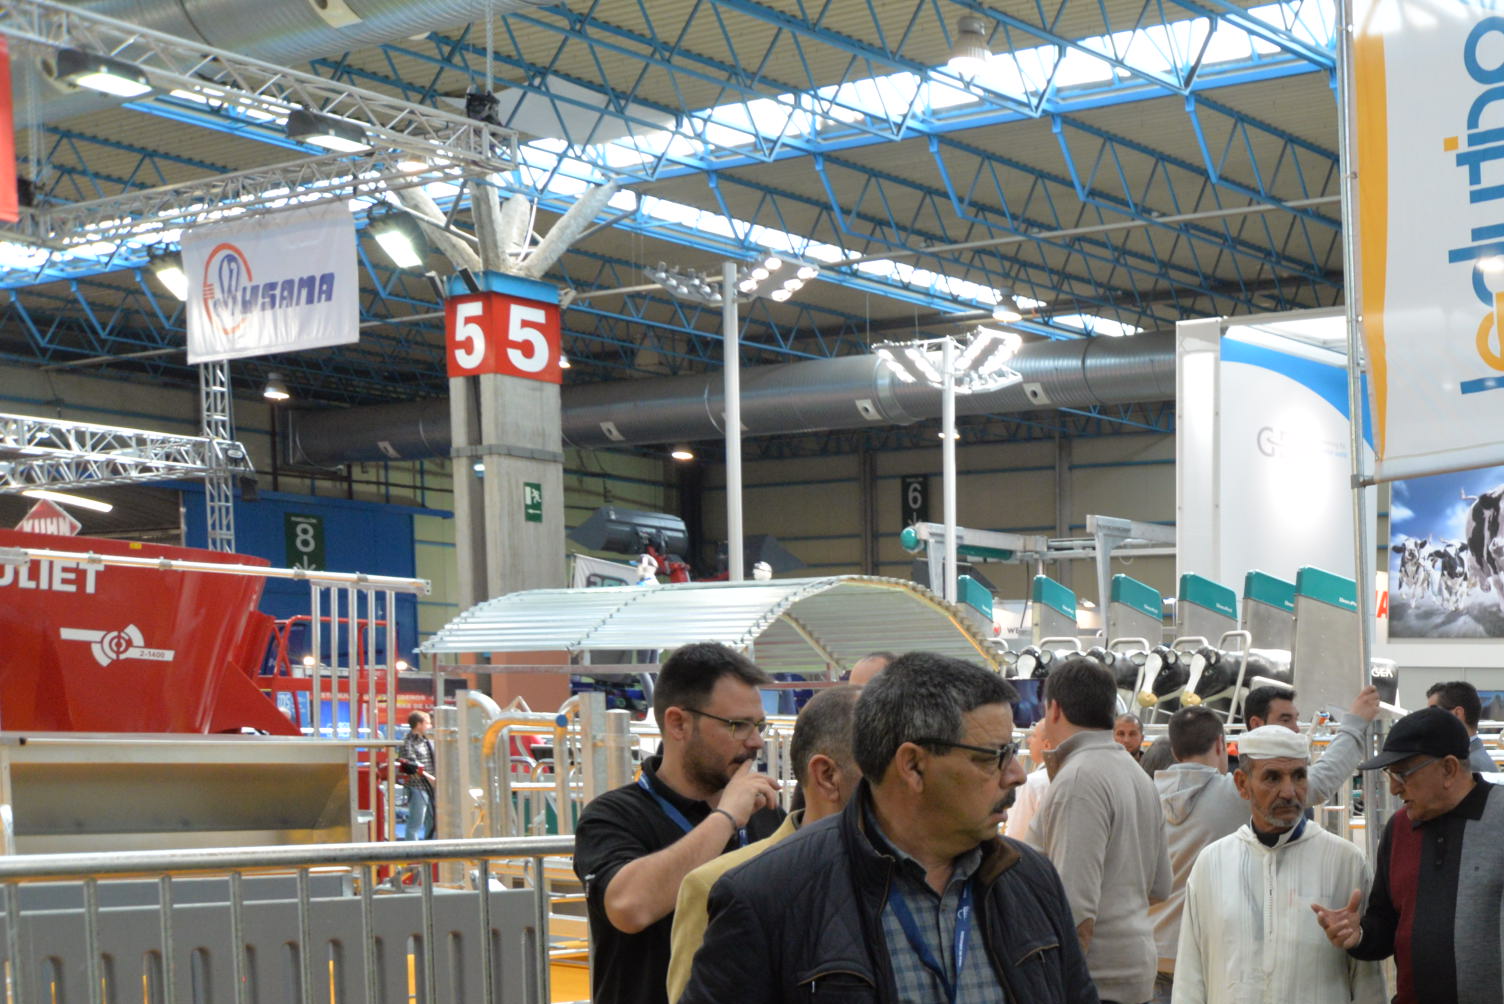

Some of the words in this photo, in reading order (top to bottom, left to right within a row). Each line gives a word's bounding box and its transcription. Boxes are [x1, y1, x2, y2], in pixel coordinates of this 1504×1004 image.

[454, 301, 486, 370] 5
[506, 304, 550, 373] 5
[908, 482, 922, 509] 6
[296, 523, 315, 552] 8
